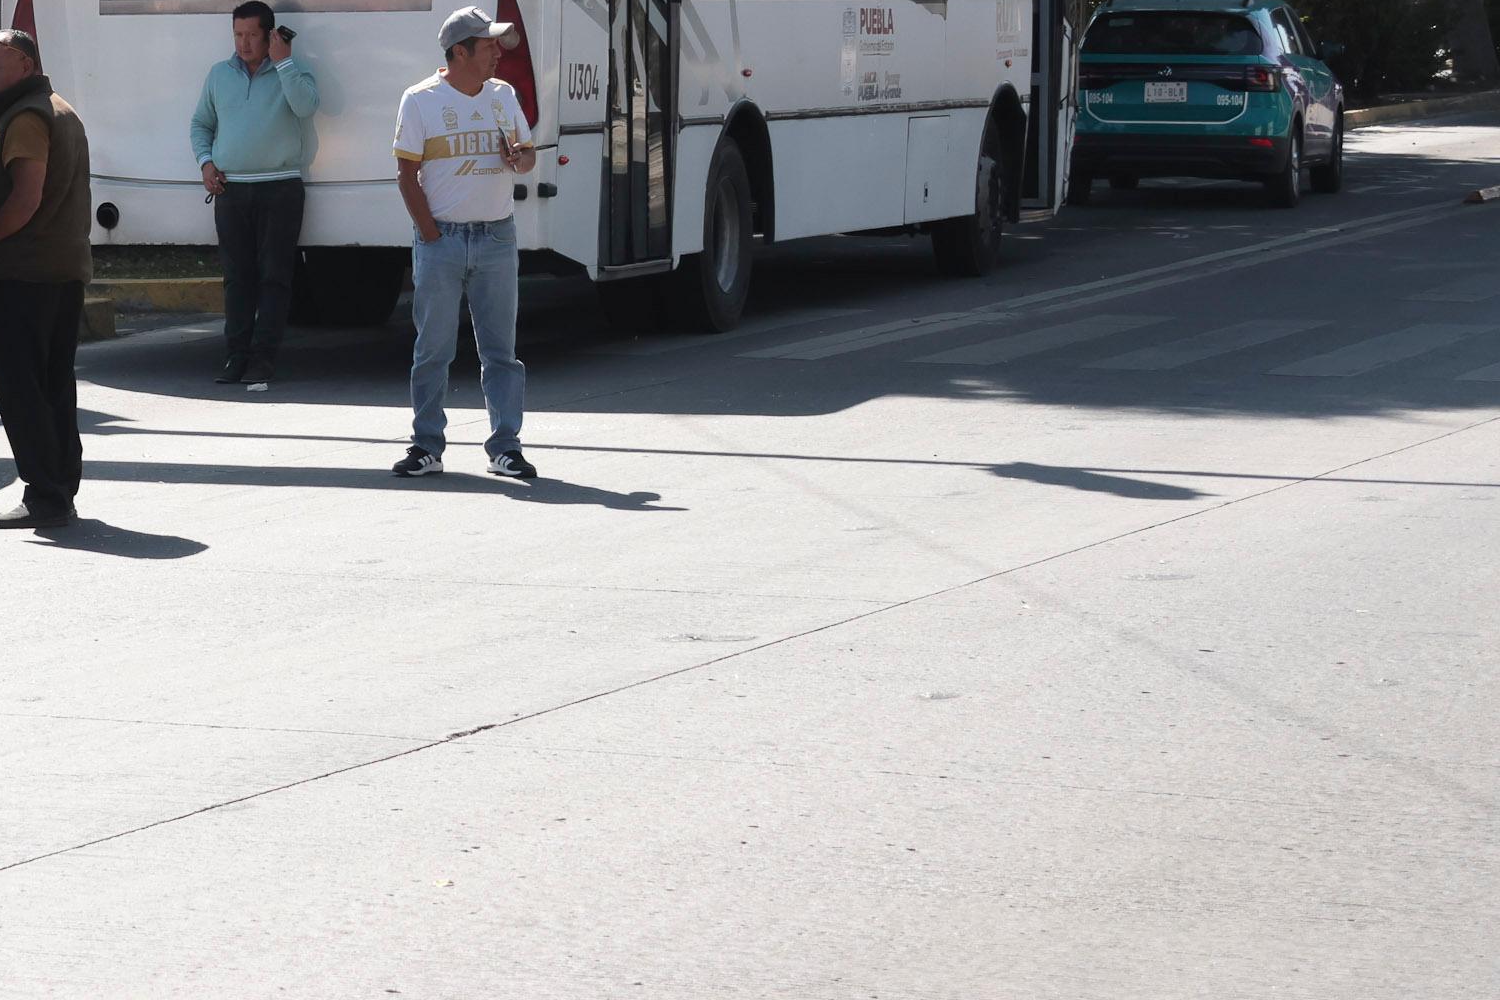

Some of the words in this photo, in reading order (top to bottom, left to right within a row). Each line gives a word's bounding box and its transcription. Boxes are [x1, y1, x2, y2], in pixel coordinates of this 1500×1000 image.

[860, 7, 894, 35] PUEBLA
[568, 63, 599, 101] U304
[446, 131, 502, 156] TIGRE
